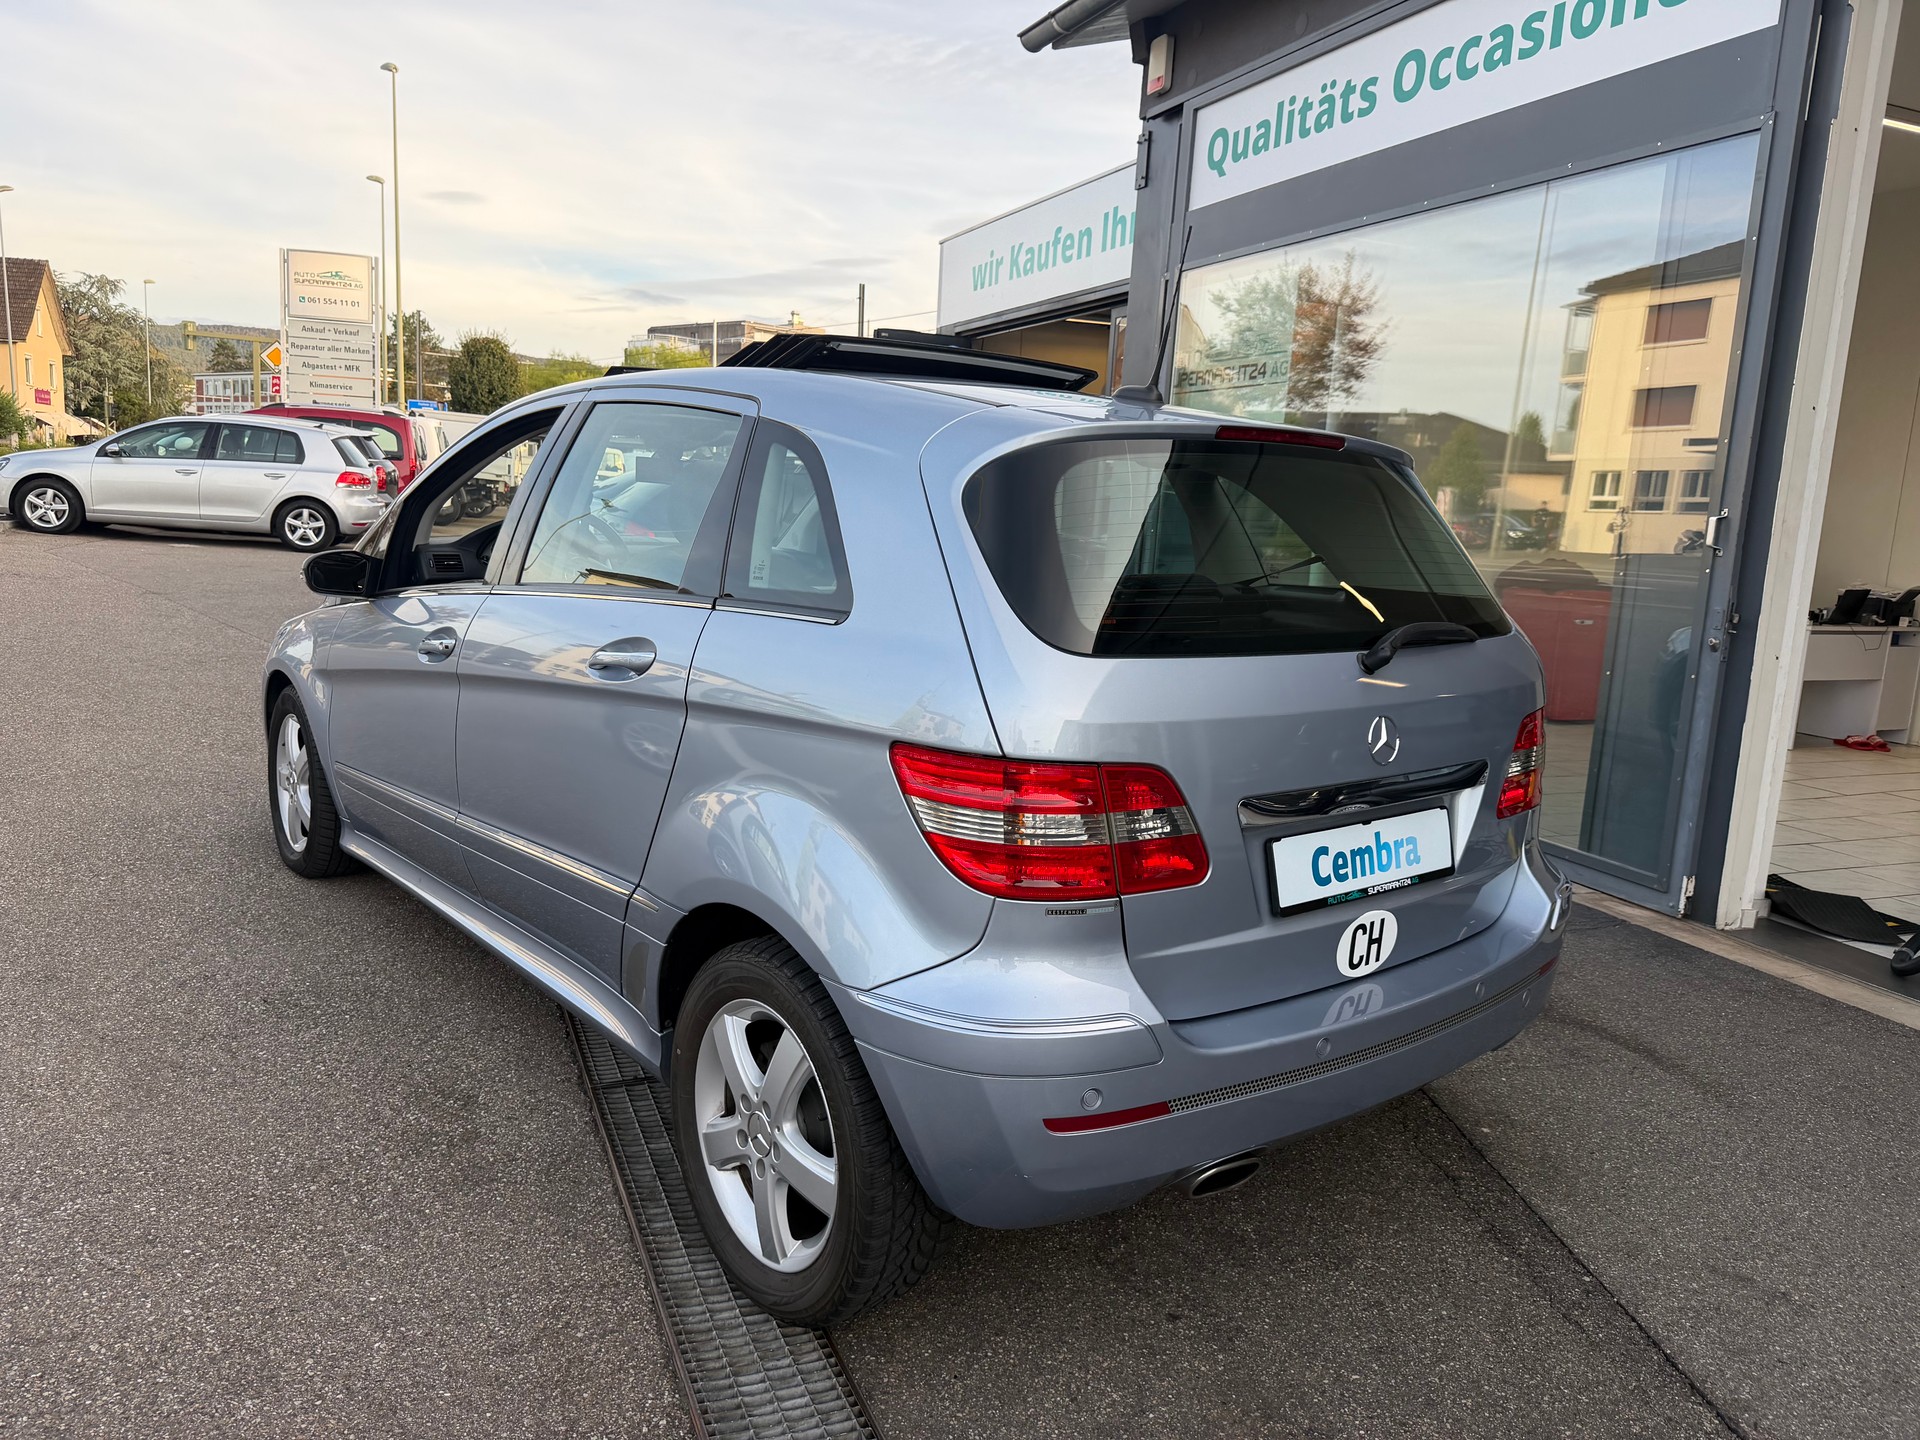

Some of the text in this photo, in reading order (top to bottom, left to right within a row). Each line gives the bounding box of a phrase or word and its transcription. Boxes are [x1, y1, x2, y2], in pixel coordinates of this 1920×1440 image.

[1207, 0, 1688, 178] Qualitäts Occasio
[972, 249, 1004, 292] wir
[1008, 226, 1093, 281] Kaufen
[293, 271, 316, 279] AUTO
[307, 296, 321, 304] 061
[323, 297, 338, 305] 554
[350, 300, 360, 308] 01
[301, 325, 326, 334] Ankauf
[333, 327, 360, 336] Verkauf
[290, 341, 370, 355] Reparatur aller Marken
[301, 361, 337, 371] Abgastest
[344, 364, 361, 373] MFK
[1269, 360, 1289, 378] AG
[309, 380, 353, 391] Klimaservice
[1311, 830, 1421, 887] Cembra
[1327, 894, 1346, 905] AUTO
[1348, 917, 1386, 971] CH
